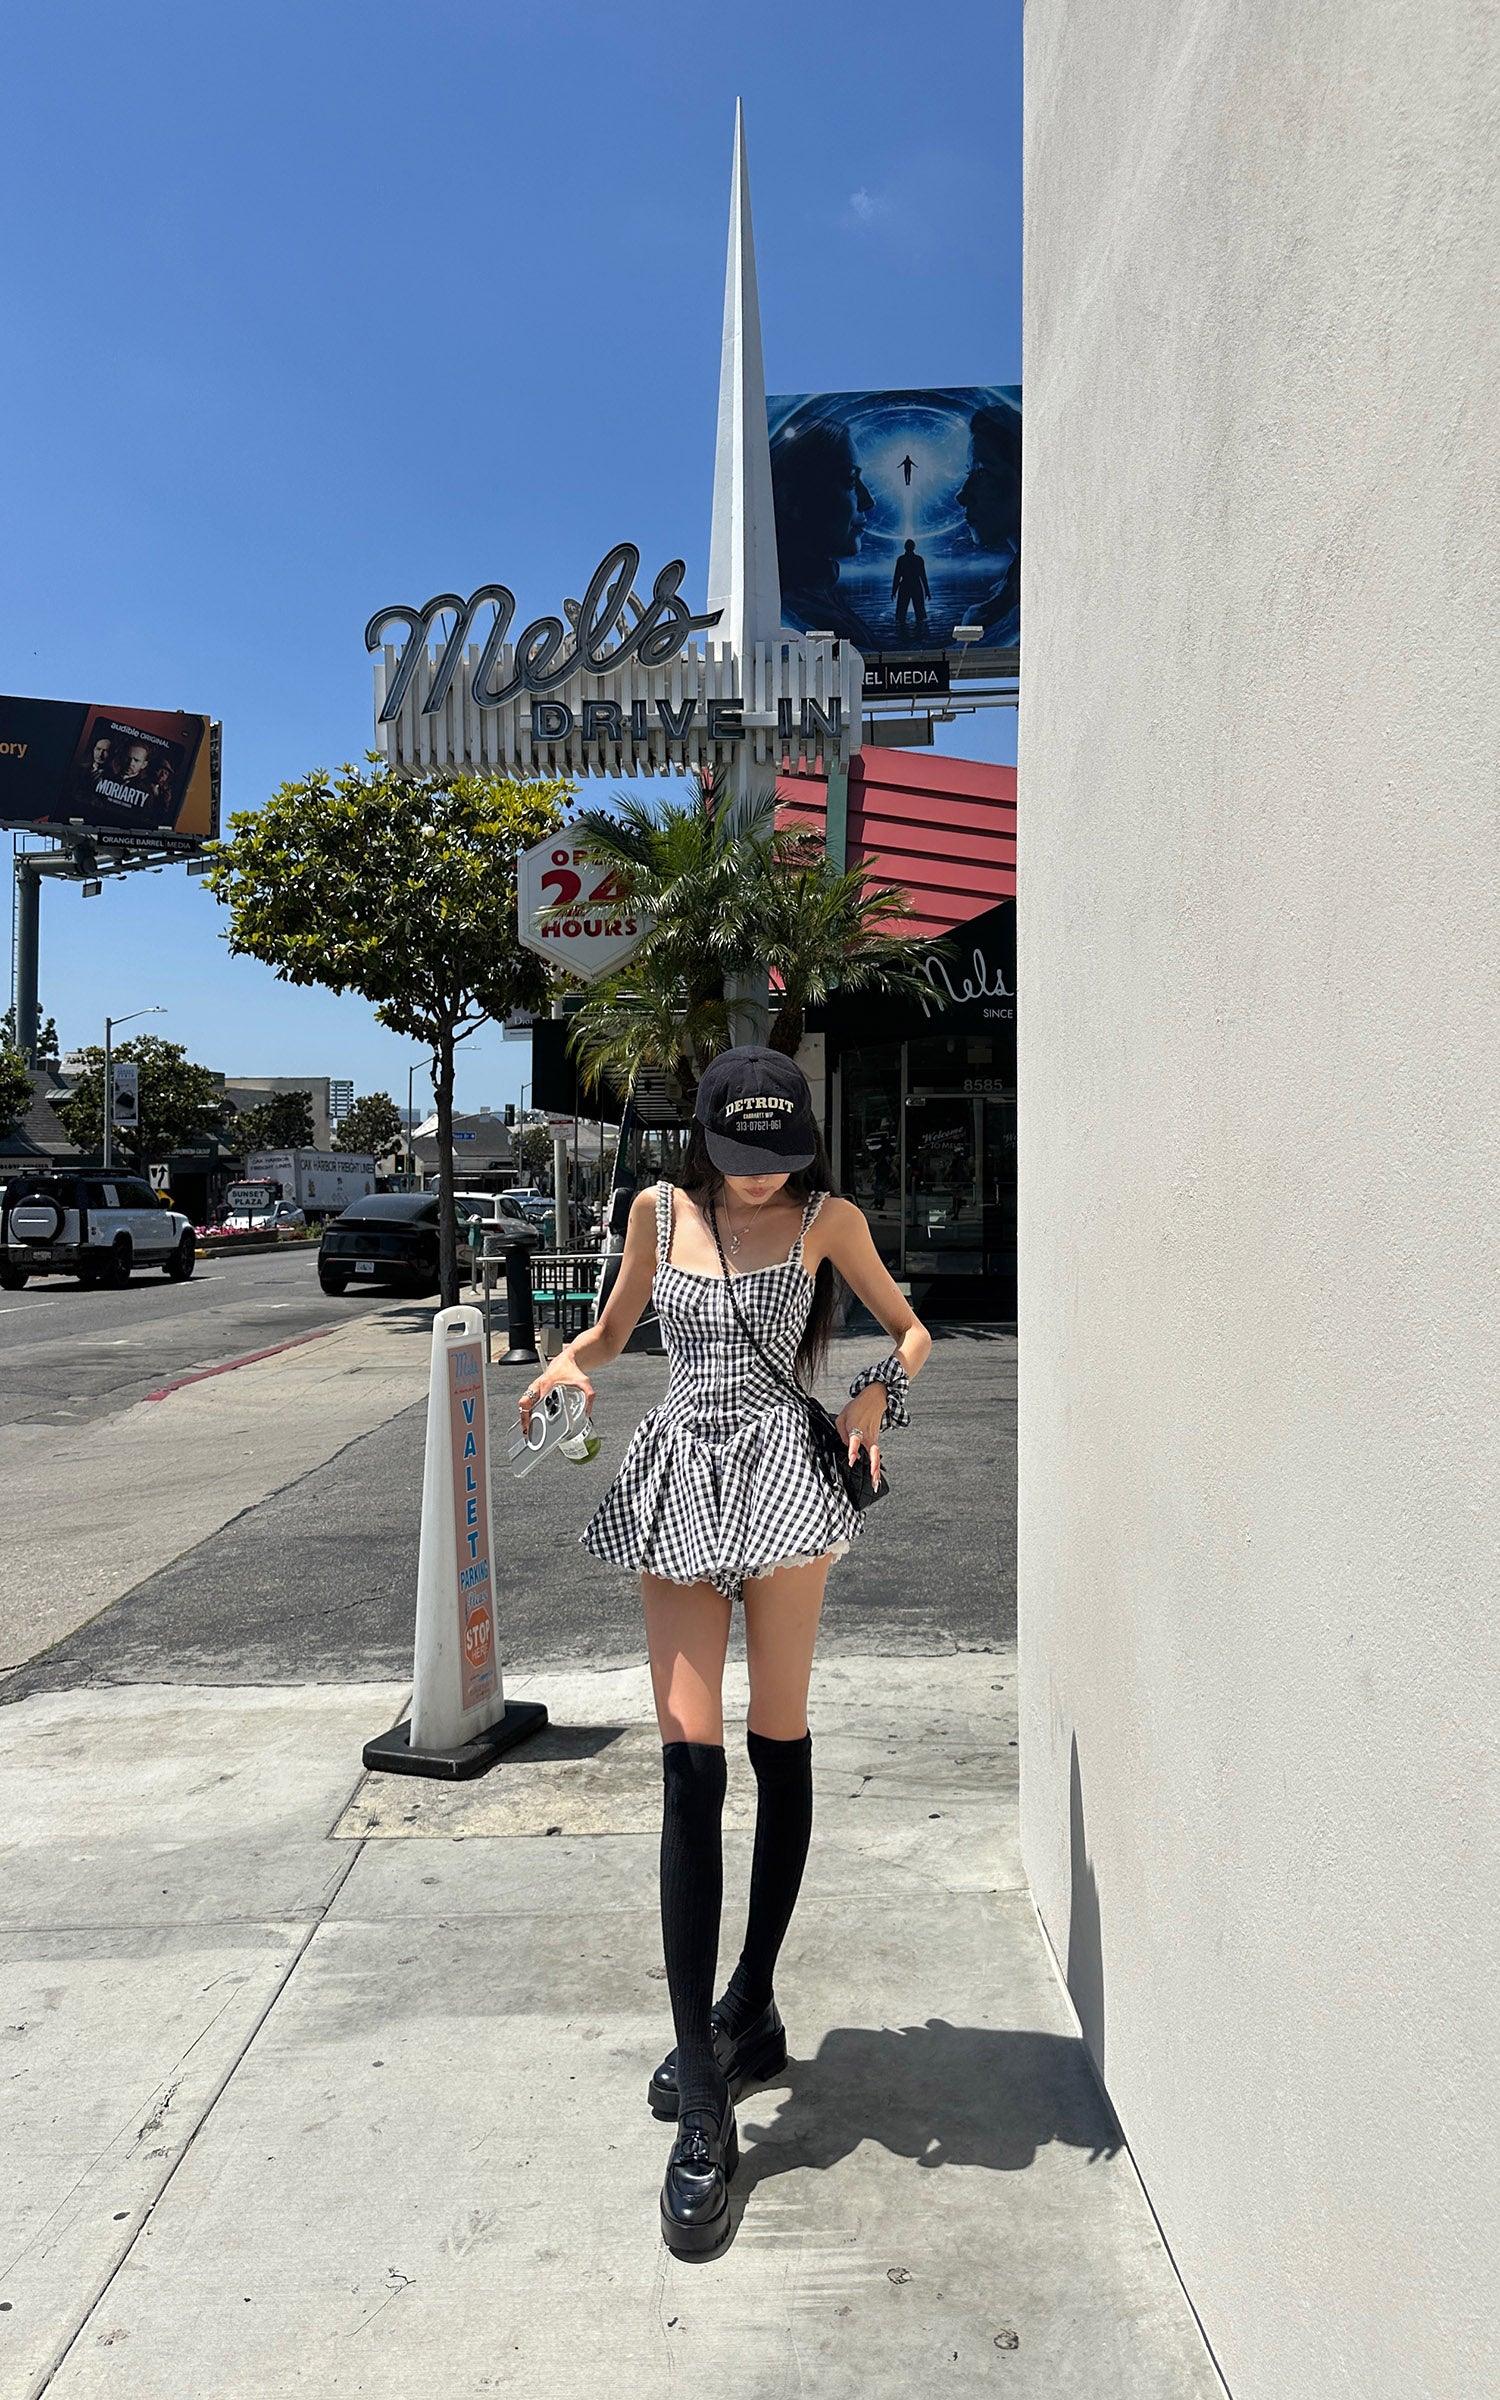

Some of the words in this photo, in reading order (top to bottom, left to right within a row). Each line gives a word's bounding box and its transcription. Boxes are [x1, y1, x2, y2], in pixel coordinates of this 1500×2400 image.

[365, 542, 725, 724] Mels
[889, 670, 938, 685] MEDIA
[531, 698, 746, 742] DRIVE
[777, 697, 843, 741] IN
[110, 722, 140, 738] audible
[139, 731, 170, 749] ORIGINAL
[0, 742, 28, 758] ory
[95, 778, 149, 808] MORIARTY
[102, 835, 135, 845] ORANGE
[136, 838, 164, 847] BARREL
[167, 840, 191, 849] MEDIA
[541, 868, 634, 917] 24
[541, 917, 638, 938] HOURS
[912, 948, 1015, 1018] Mels
[983, 1008, 1014, 1019] SINCE
[963, 1079, 1003, 1092] 8585
[725, 1096, 794, 1118] DETROIT
[300, 1159, 313, 1171] OAK
[313, 1159, 337, 1173] HARBOR
[337, 1160, 359, 1174] FREIGHT
[360, 1162, 376, 1175] LINES
[231, 1189, 265, 1198] SUNSET
[234, 1198, 263, 1206] PLAZA
[461, 1397, 478, 1559] VALET
[460, 1559, 490, 1592] PARKING
[466, 1619, 491, 1650] STOP
[471, 1642, 489, 1660] HERE
